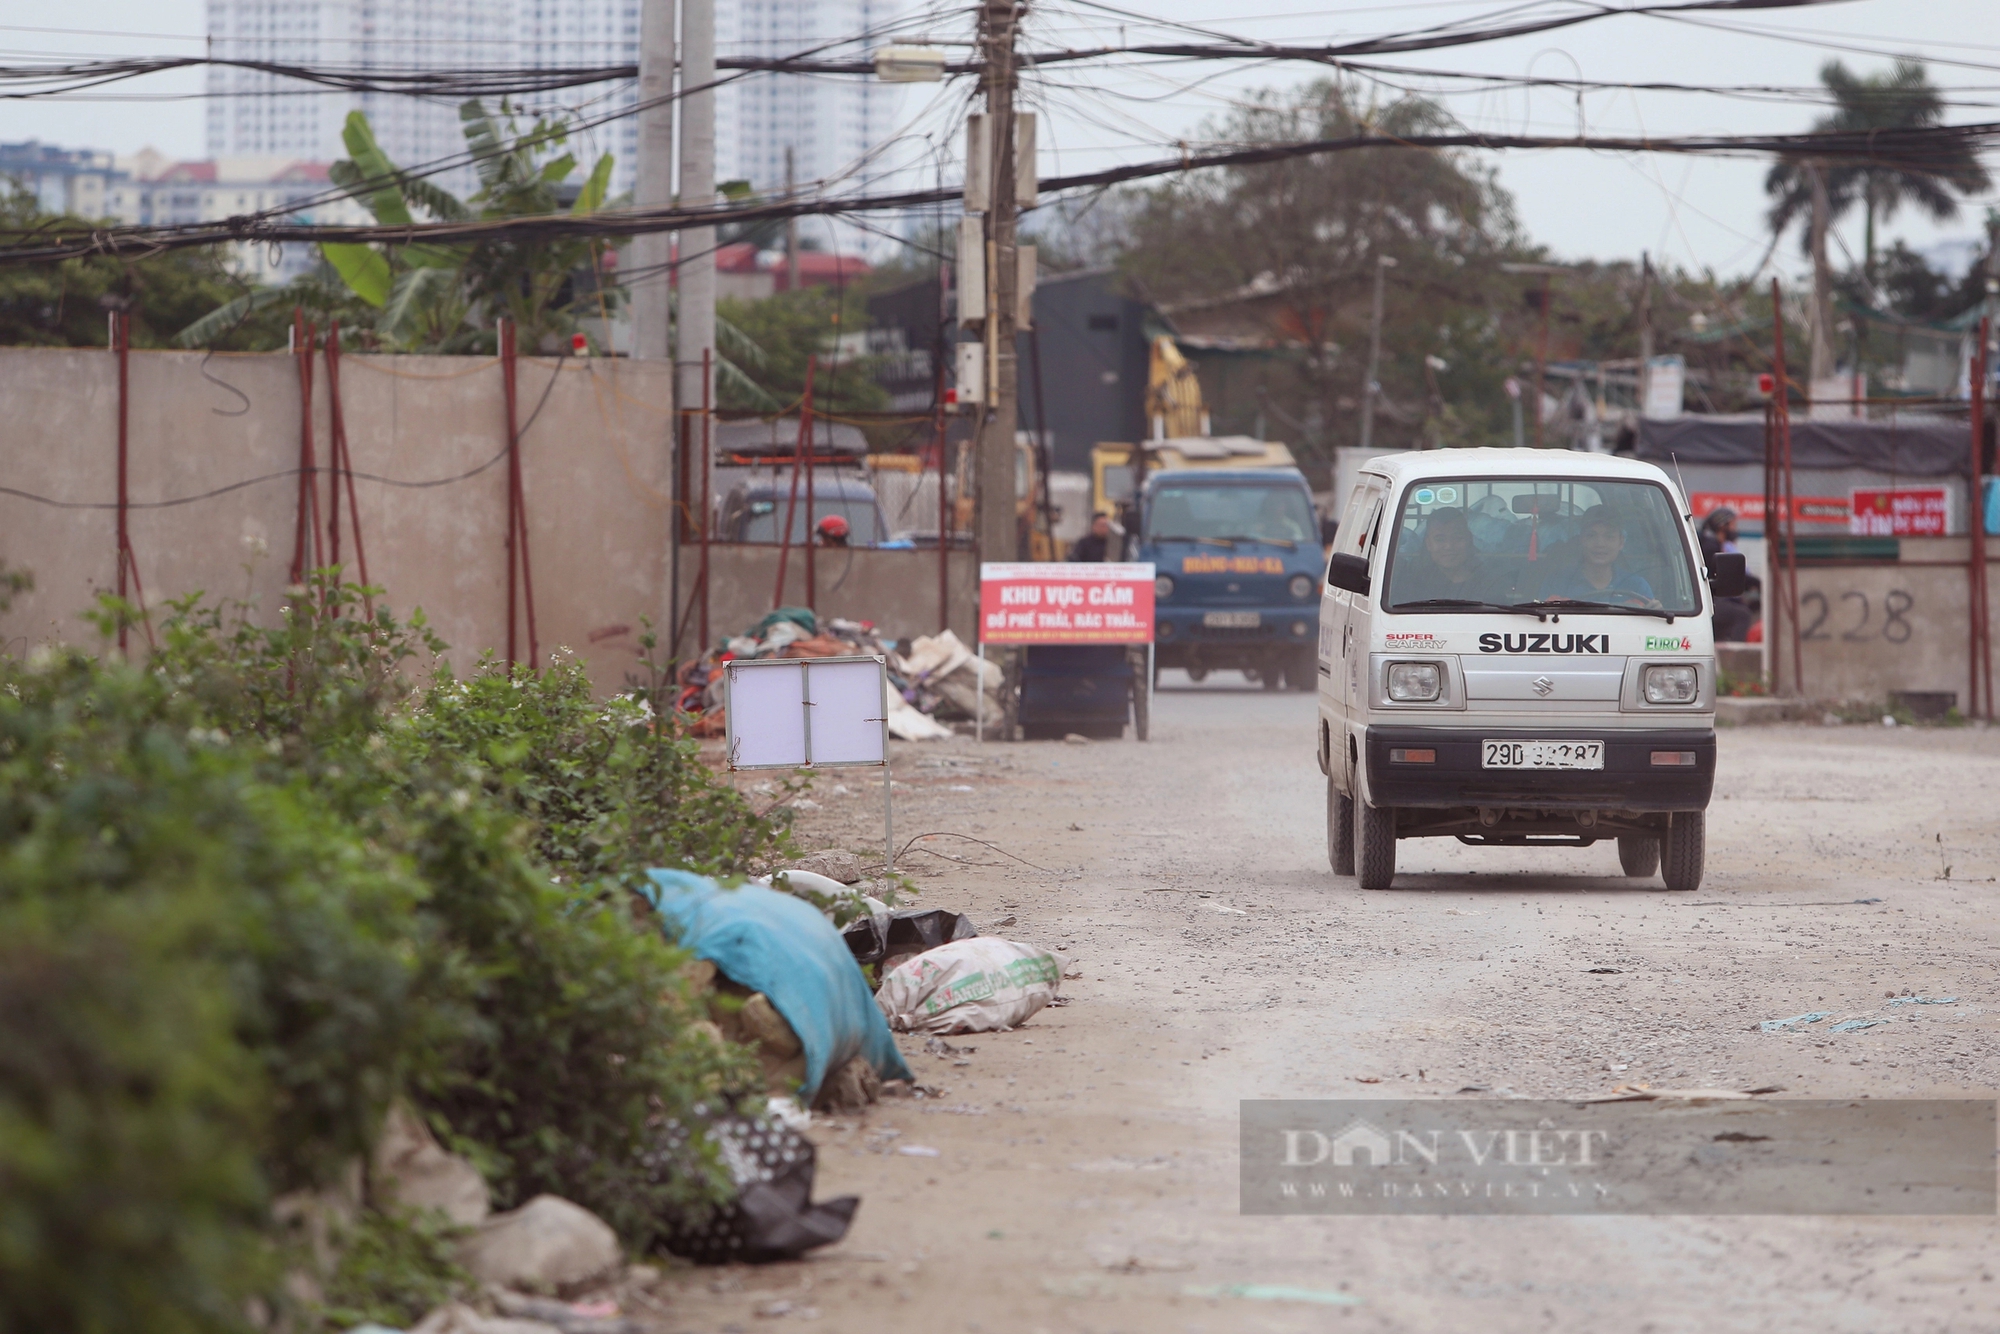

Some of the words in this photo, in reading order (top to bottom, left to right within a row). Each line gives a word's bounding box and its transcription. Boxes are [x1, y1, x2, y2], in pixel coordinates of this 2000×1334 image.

[1001, 585, 1041, 605] KHU
[1045, 584, 1084, 608] VỰC
[1089, 581, 1134, 605] CẤM
[1801, 589, 1914, 644] 228
[1385, 640, 1447, 649] CARRY
[1478, 632, 1610, 654] SUZUKI
